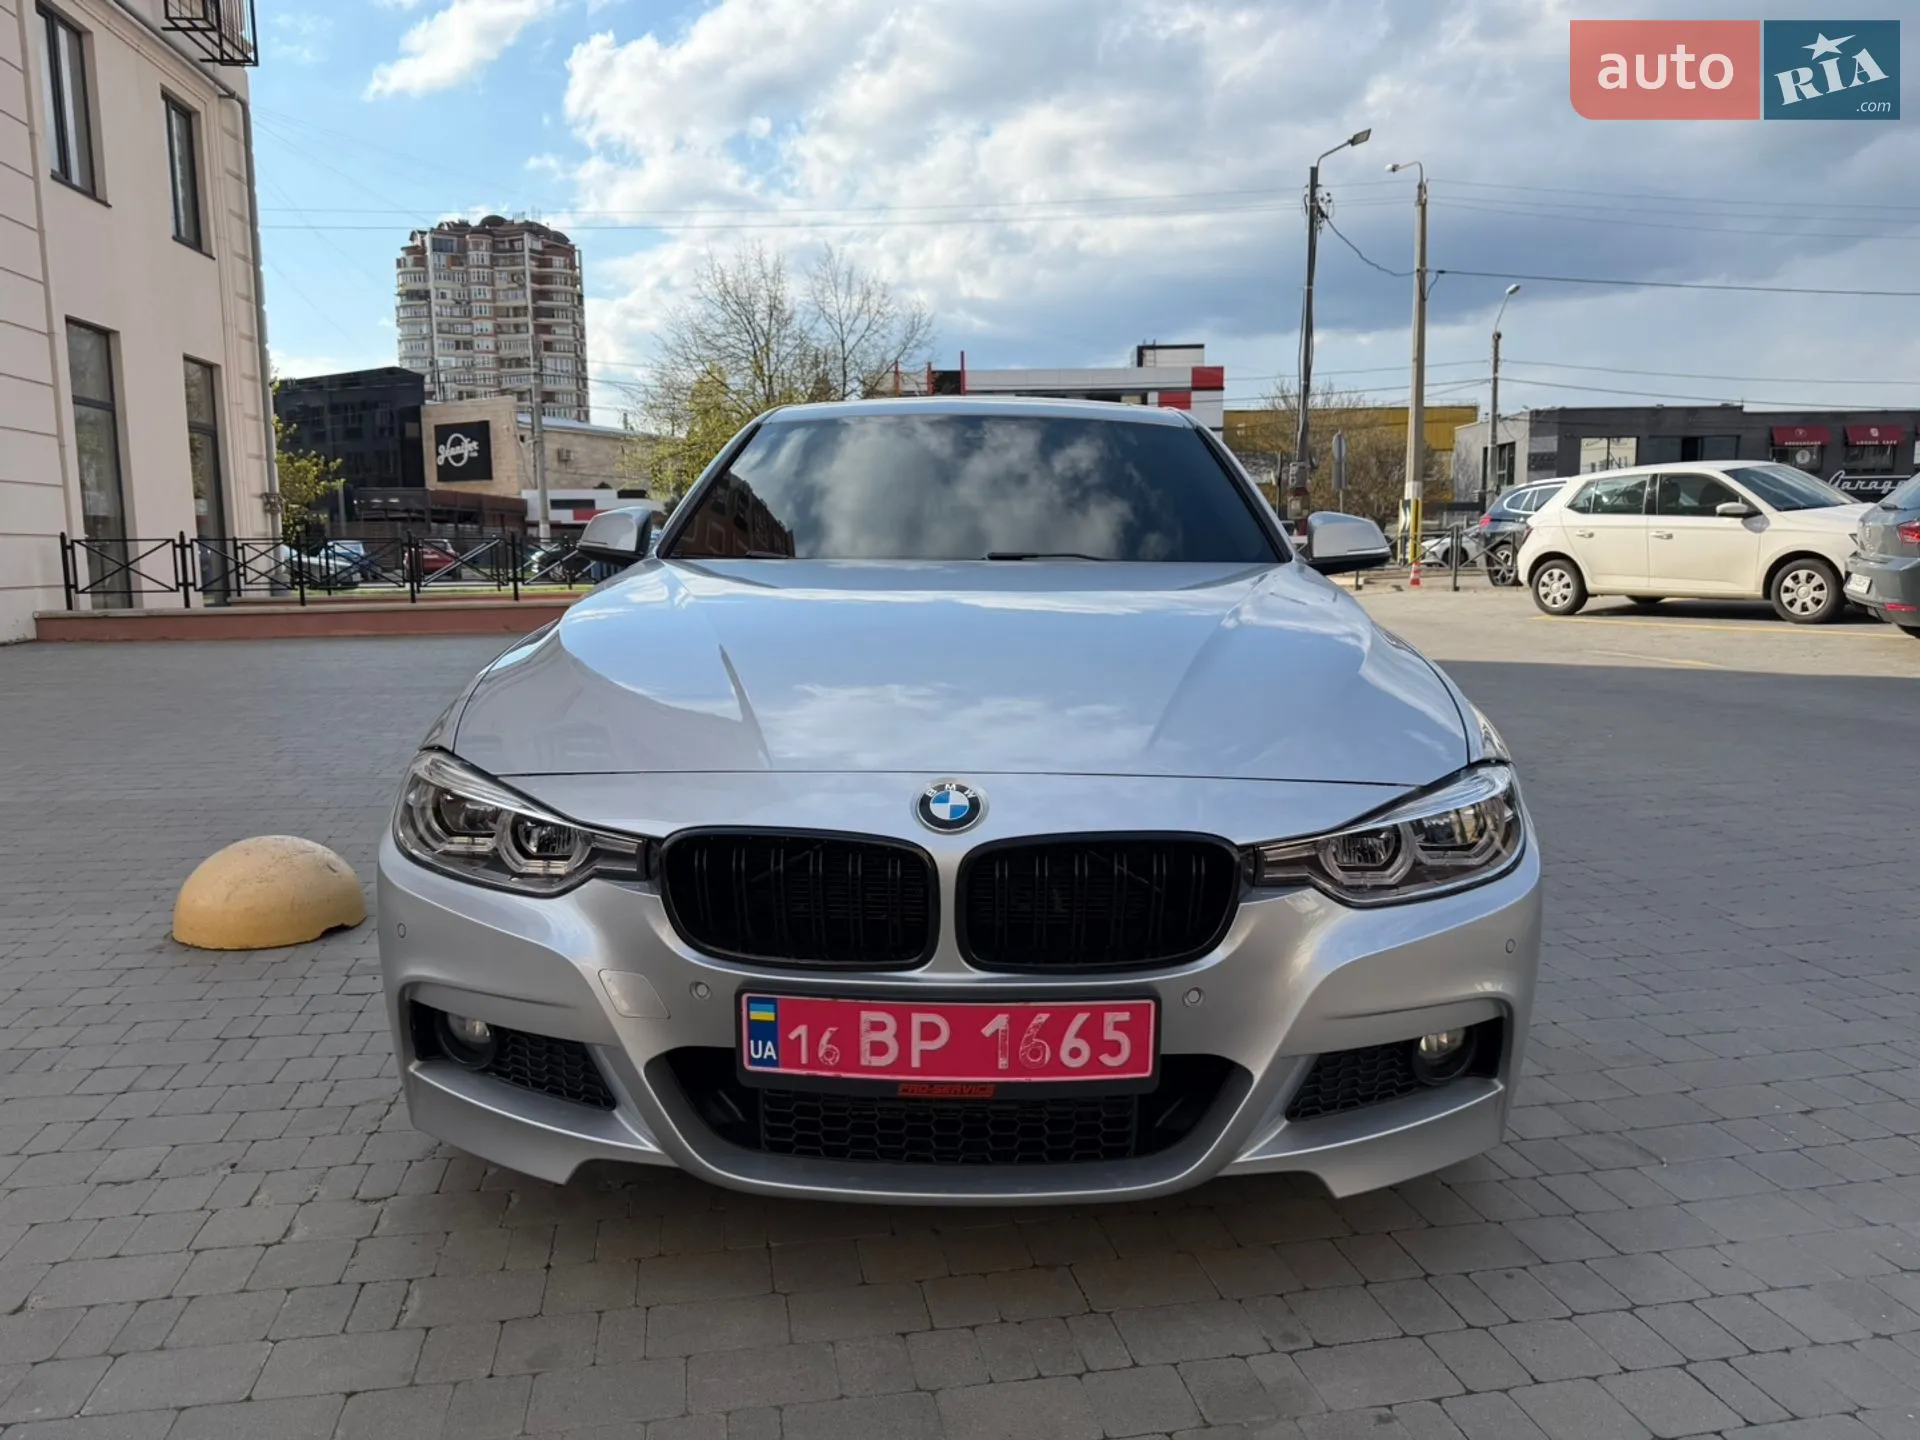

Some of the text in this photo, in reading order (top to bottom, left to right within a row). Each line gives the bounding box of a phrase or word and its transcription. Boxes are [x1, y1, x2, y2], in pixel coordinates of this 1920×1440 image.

[925, 783, 977, 798] BMW
[750, 1039, 776, 1061] UA
[788, 1010, 1133, 1070] 16 BP 1665
